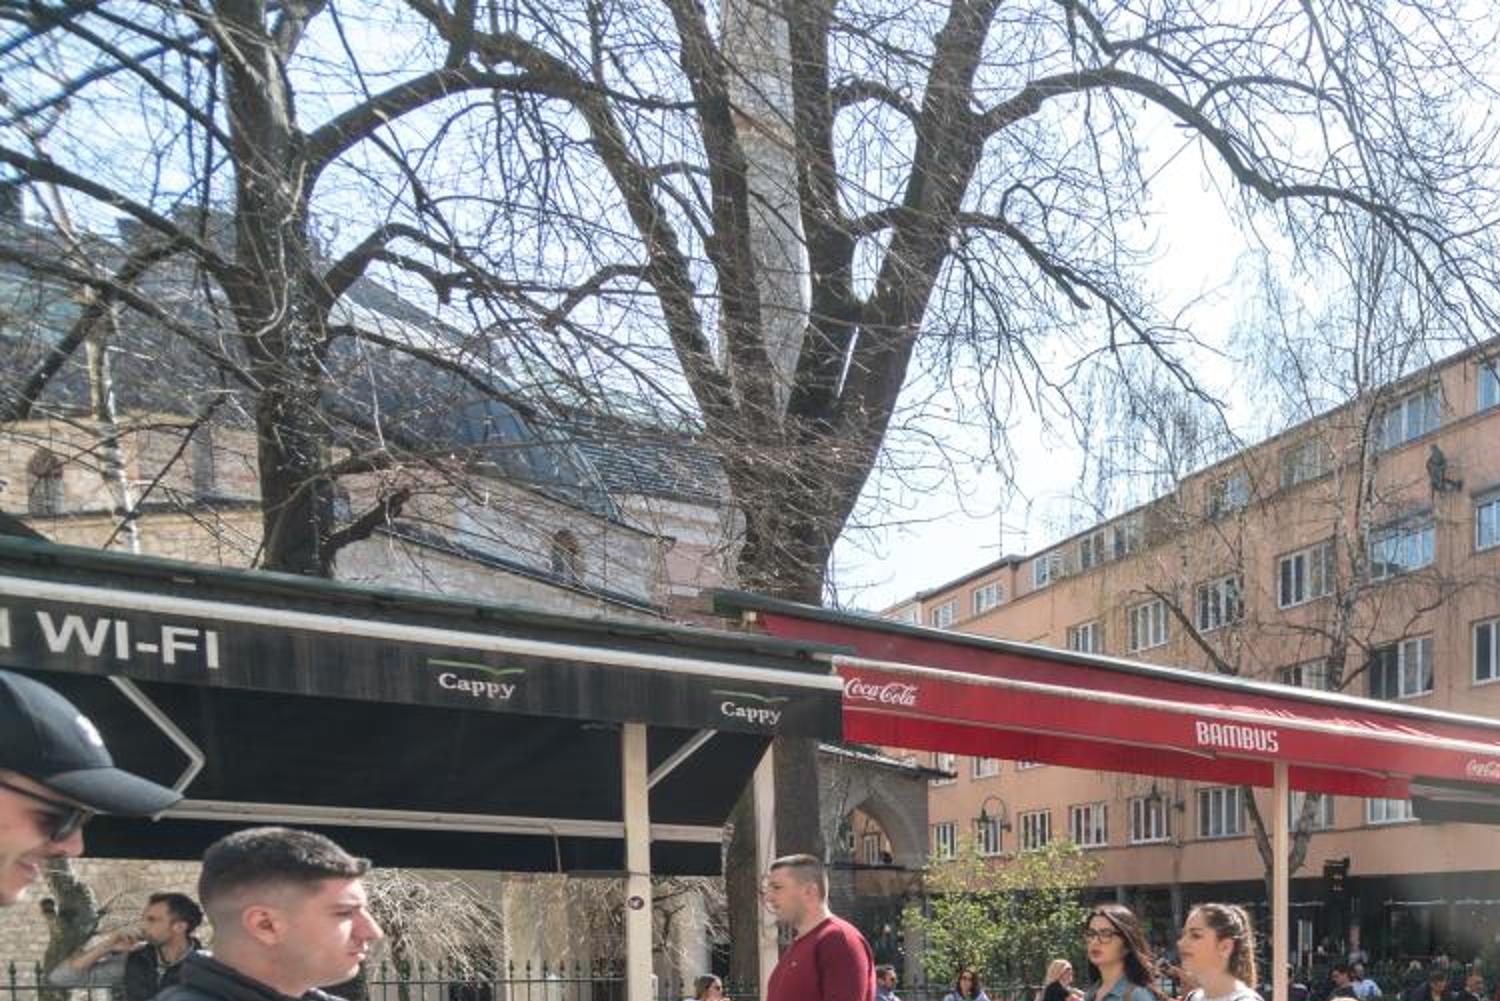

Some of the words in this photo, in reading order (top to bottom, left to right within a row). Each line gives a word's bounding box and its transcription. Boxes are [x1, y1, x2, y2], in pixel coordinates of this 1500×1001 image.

[35, 611, 220, 669] WI-FI
[438, 672, 516, 700] Cappy
[720, 701, 782, 725] Cappy
[1195, 720, 1279, 753] BAMBUS
